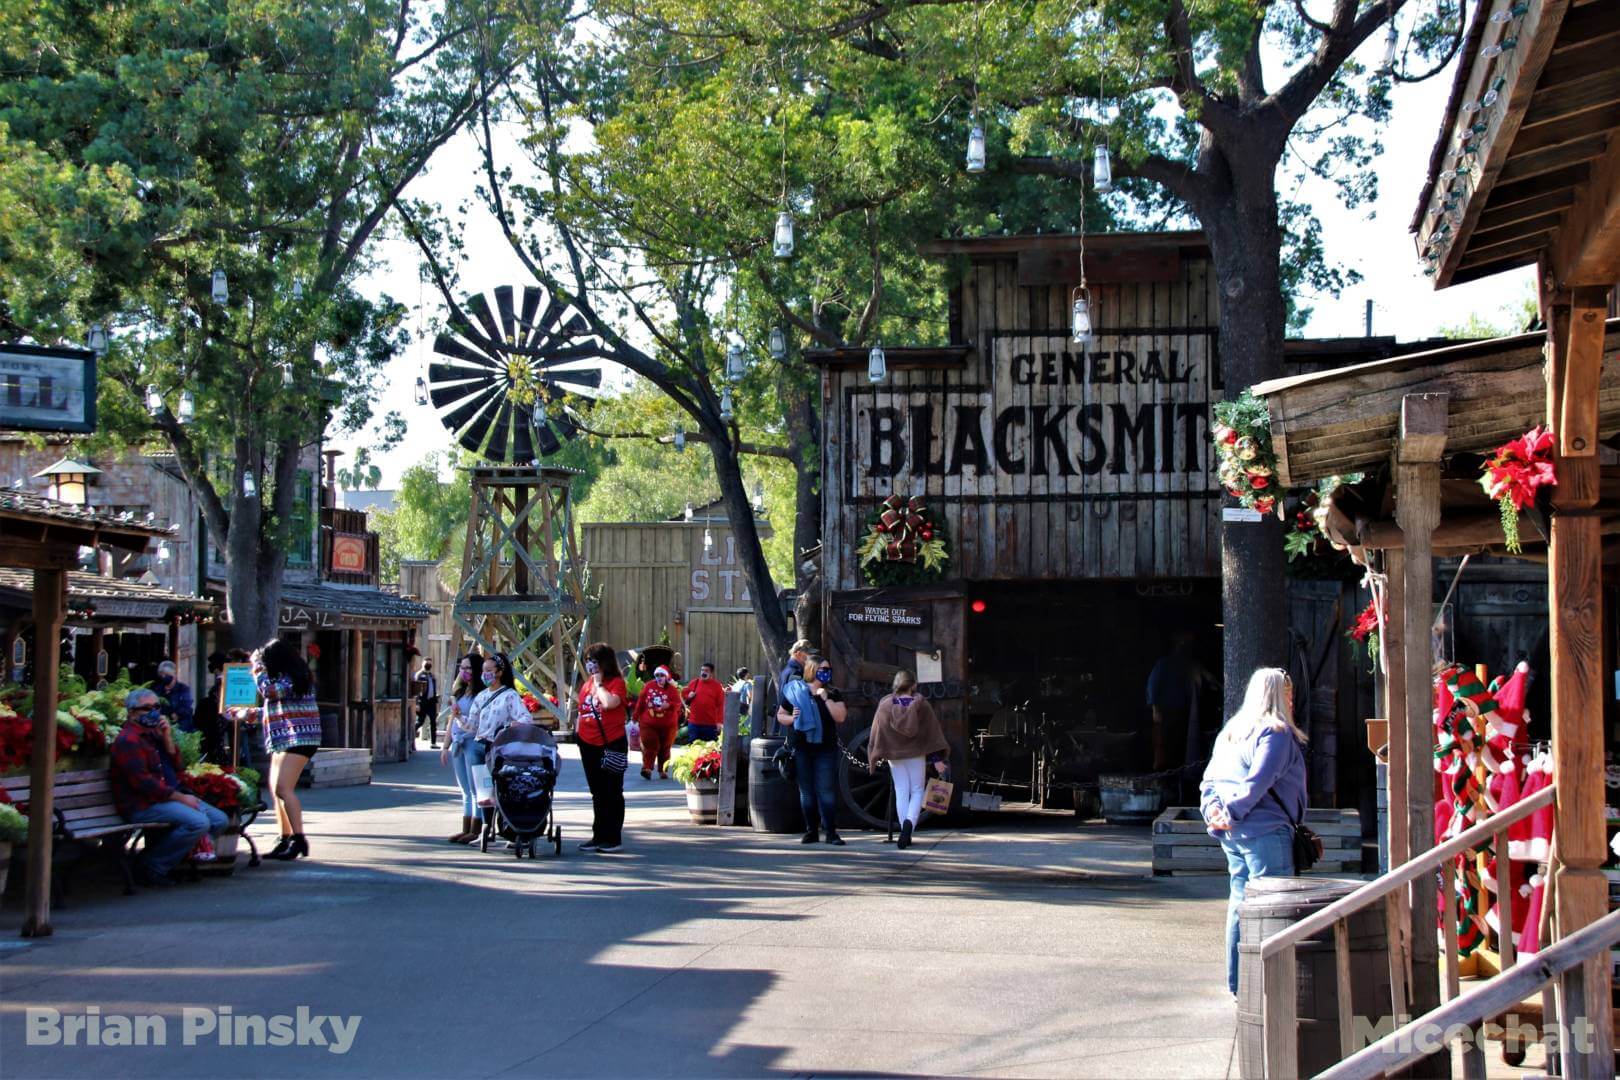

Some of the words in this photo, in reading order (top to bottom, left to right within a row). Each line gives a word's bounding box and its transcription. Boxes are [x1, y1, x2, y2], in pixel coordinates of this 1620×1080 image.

[867, 403, 1219, 476] BLACKSMIT
[281, 606, 334, 627] JAIL
[848, 613, 864, 621] FOR
[865, 614, 889, 623] FLYING
[892, 615, 921, 624] SPARKS
[864, 606, 889, 615] WATCH
[891, 608, 906, 616] OUT
